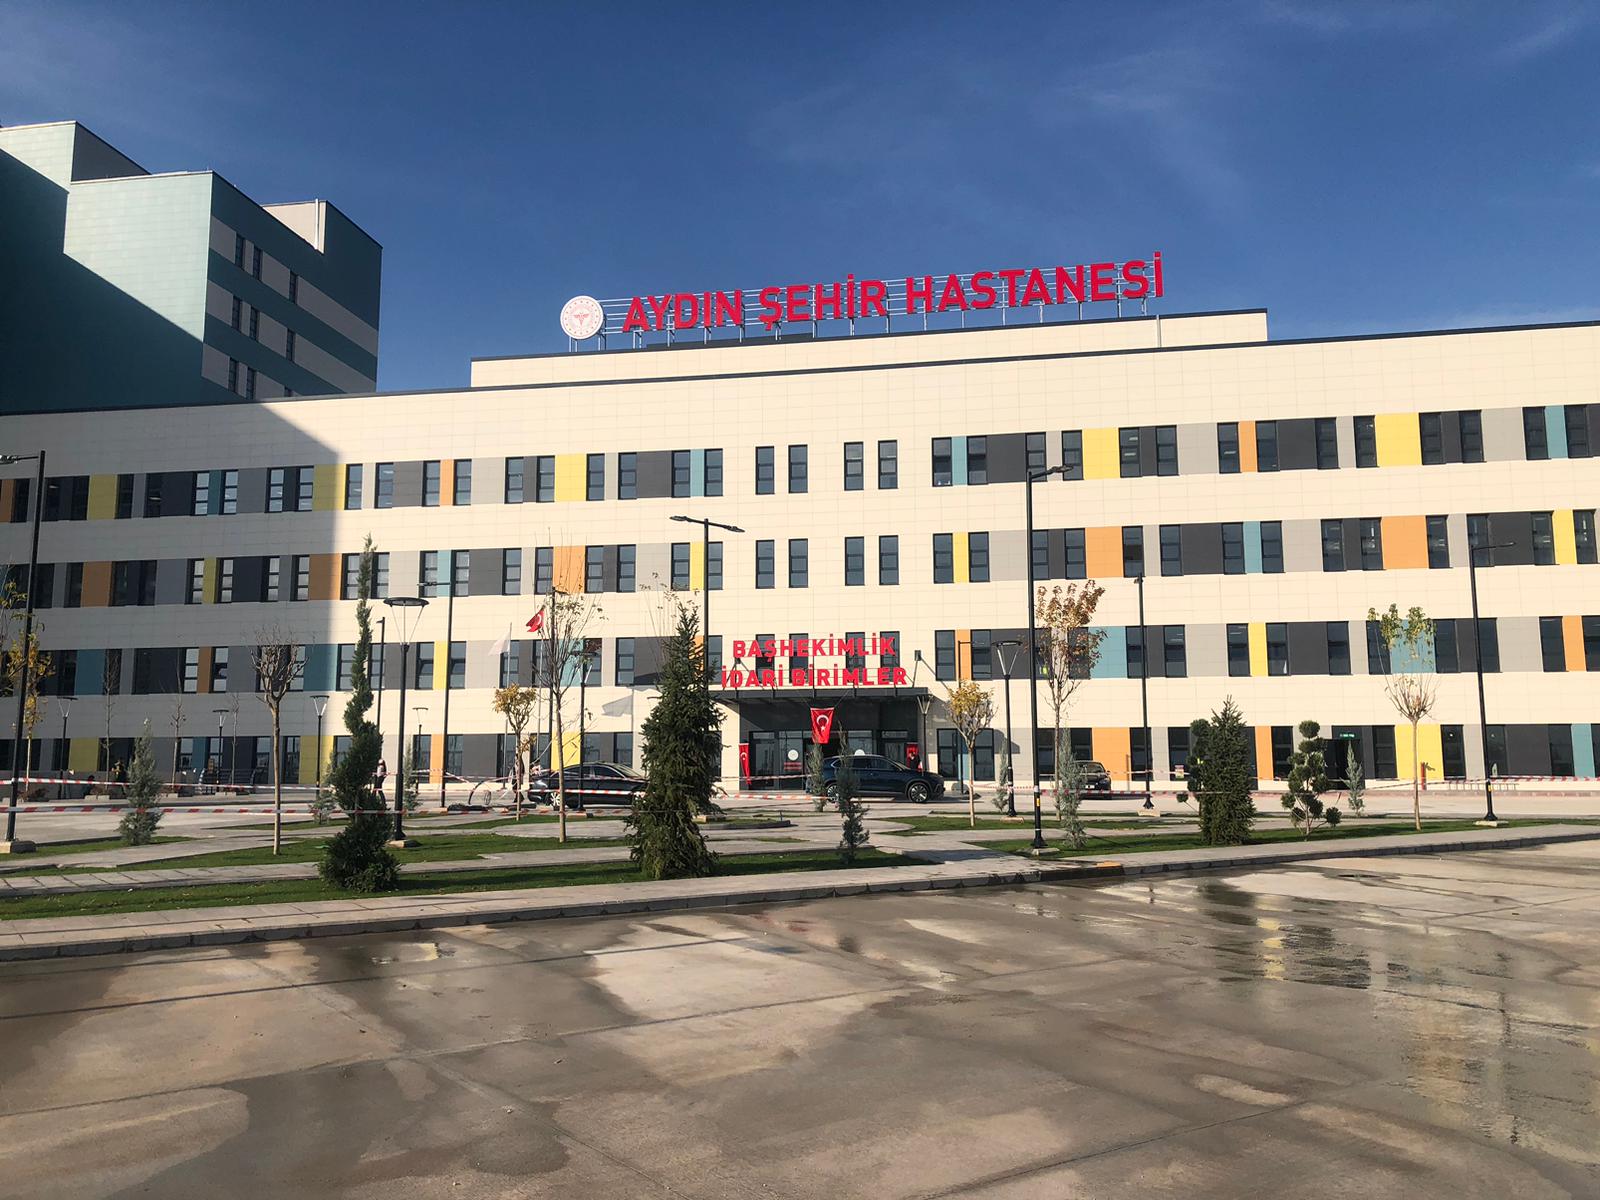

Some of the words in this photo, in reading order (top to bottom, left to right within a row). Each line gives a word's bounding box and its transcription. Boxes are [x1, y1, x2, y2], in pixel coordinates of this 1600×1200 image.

[622, 289, 742, 332] AYDIN
[758, 273, 887, 331] ŞEHİR
[905, 251, 1164, 314] HASTANESİ
[732, 633, 896, 663] BAŞHEKİMLİK
[721, 663, 784, 688] İDARİ
[791, 663, 908, 688] BİRİMLER
